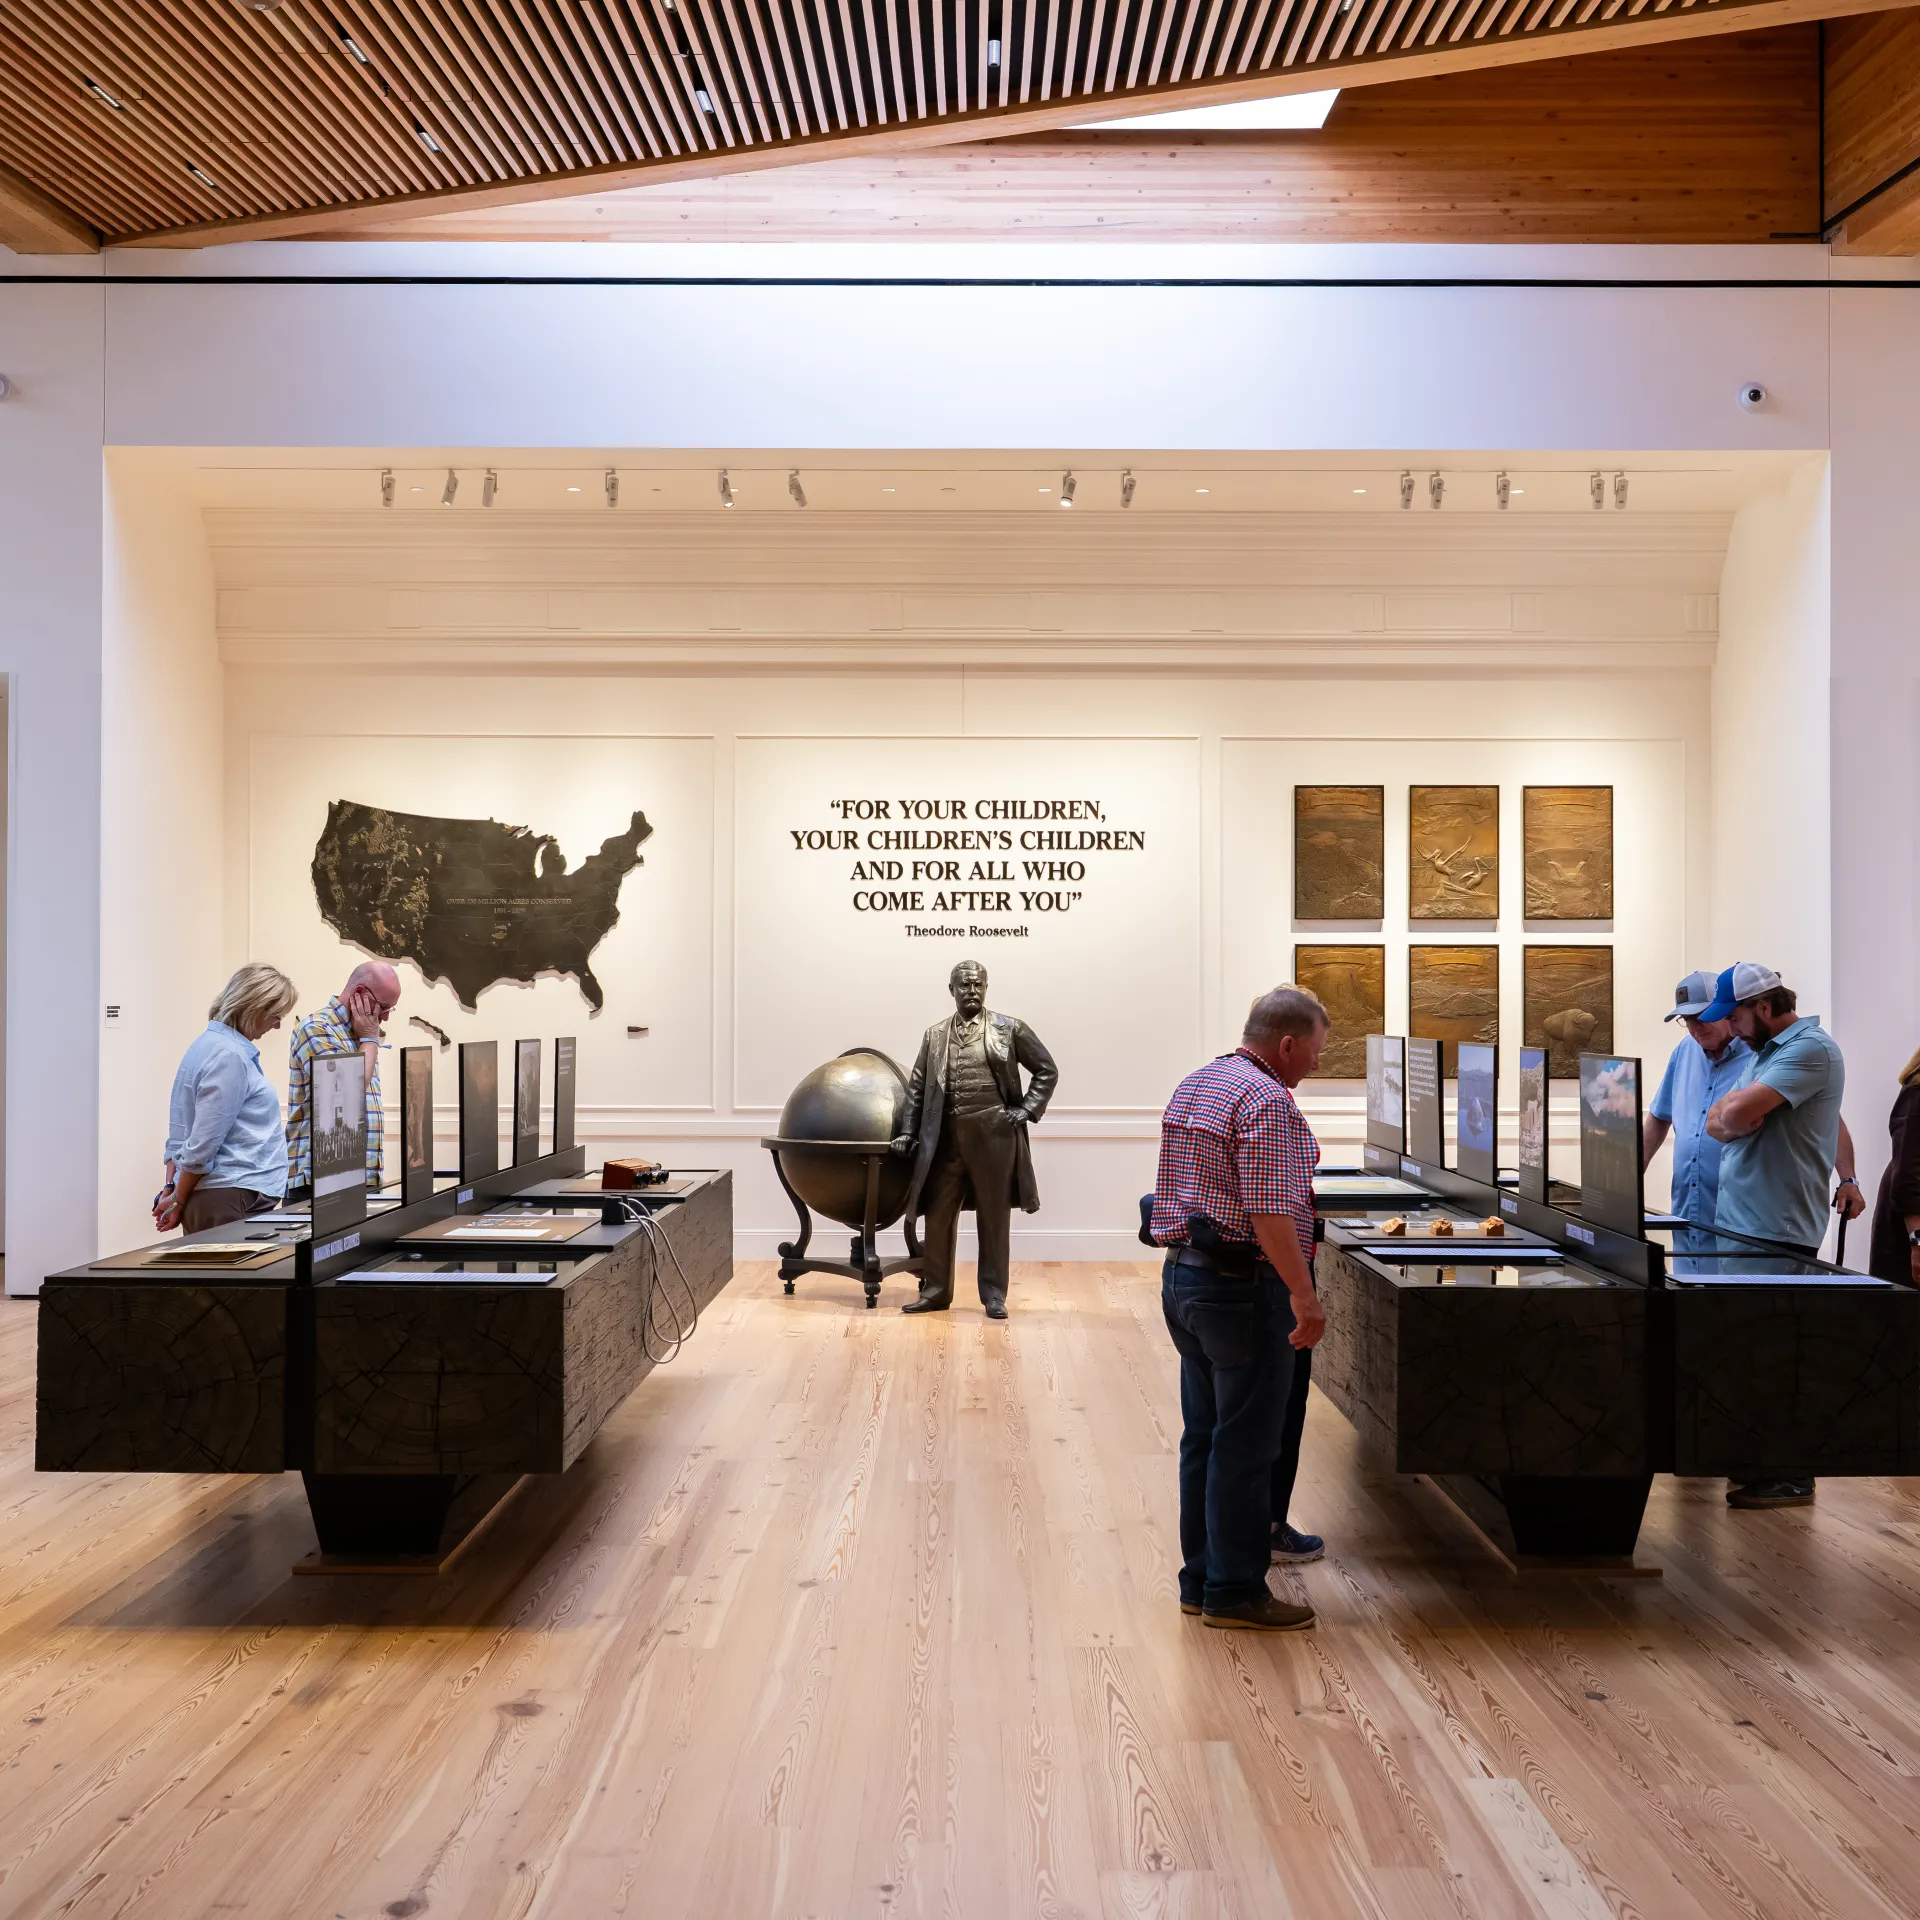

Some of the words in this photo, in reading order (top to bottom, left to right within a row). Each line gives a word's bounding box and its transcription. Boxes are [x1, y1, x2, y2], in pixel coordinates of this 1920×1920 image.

[830, 799, 892, 820] “FOR
[898, 799, 968, 820] YOUR
[974, 799, 1107, 823] CHILDREN,
[790, 830, 860, 851] YOUR
[867, 830, 1013, 851] CHILDREN’S
[1019, 830, 1146, 851] CHILDREN
[849, 860, 904, 881] AND
[911, 860, 962, 881] FOR
[968, 860, 1015, 881] ALL
[1022, 860, 1086, 881] WHO
[852, 890, 925, 912] COME
[931, 890, 1013, 912] AFTER
[1018, 890, 1083, 912] YOU”
[904, 925, 966, 937] Theodore
[969, 925, 1029, 937] Roosevelt
